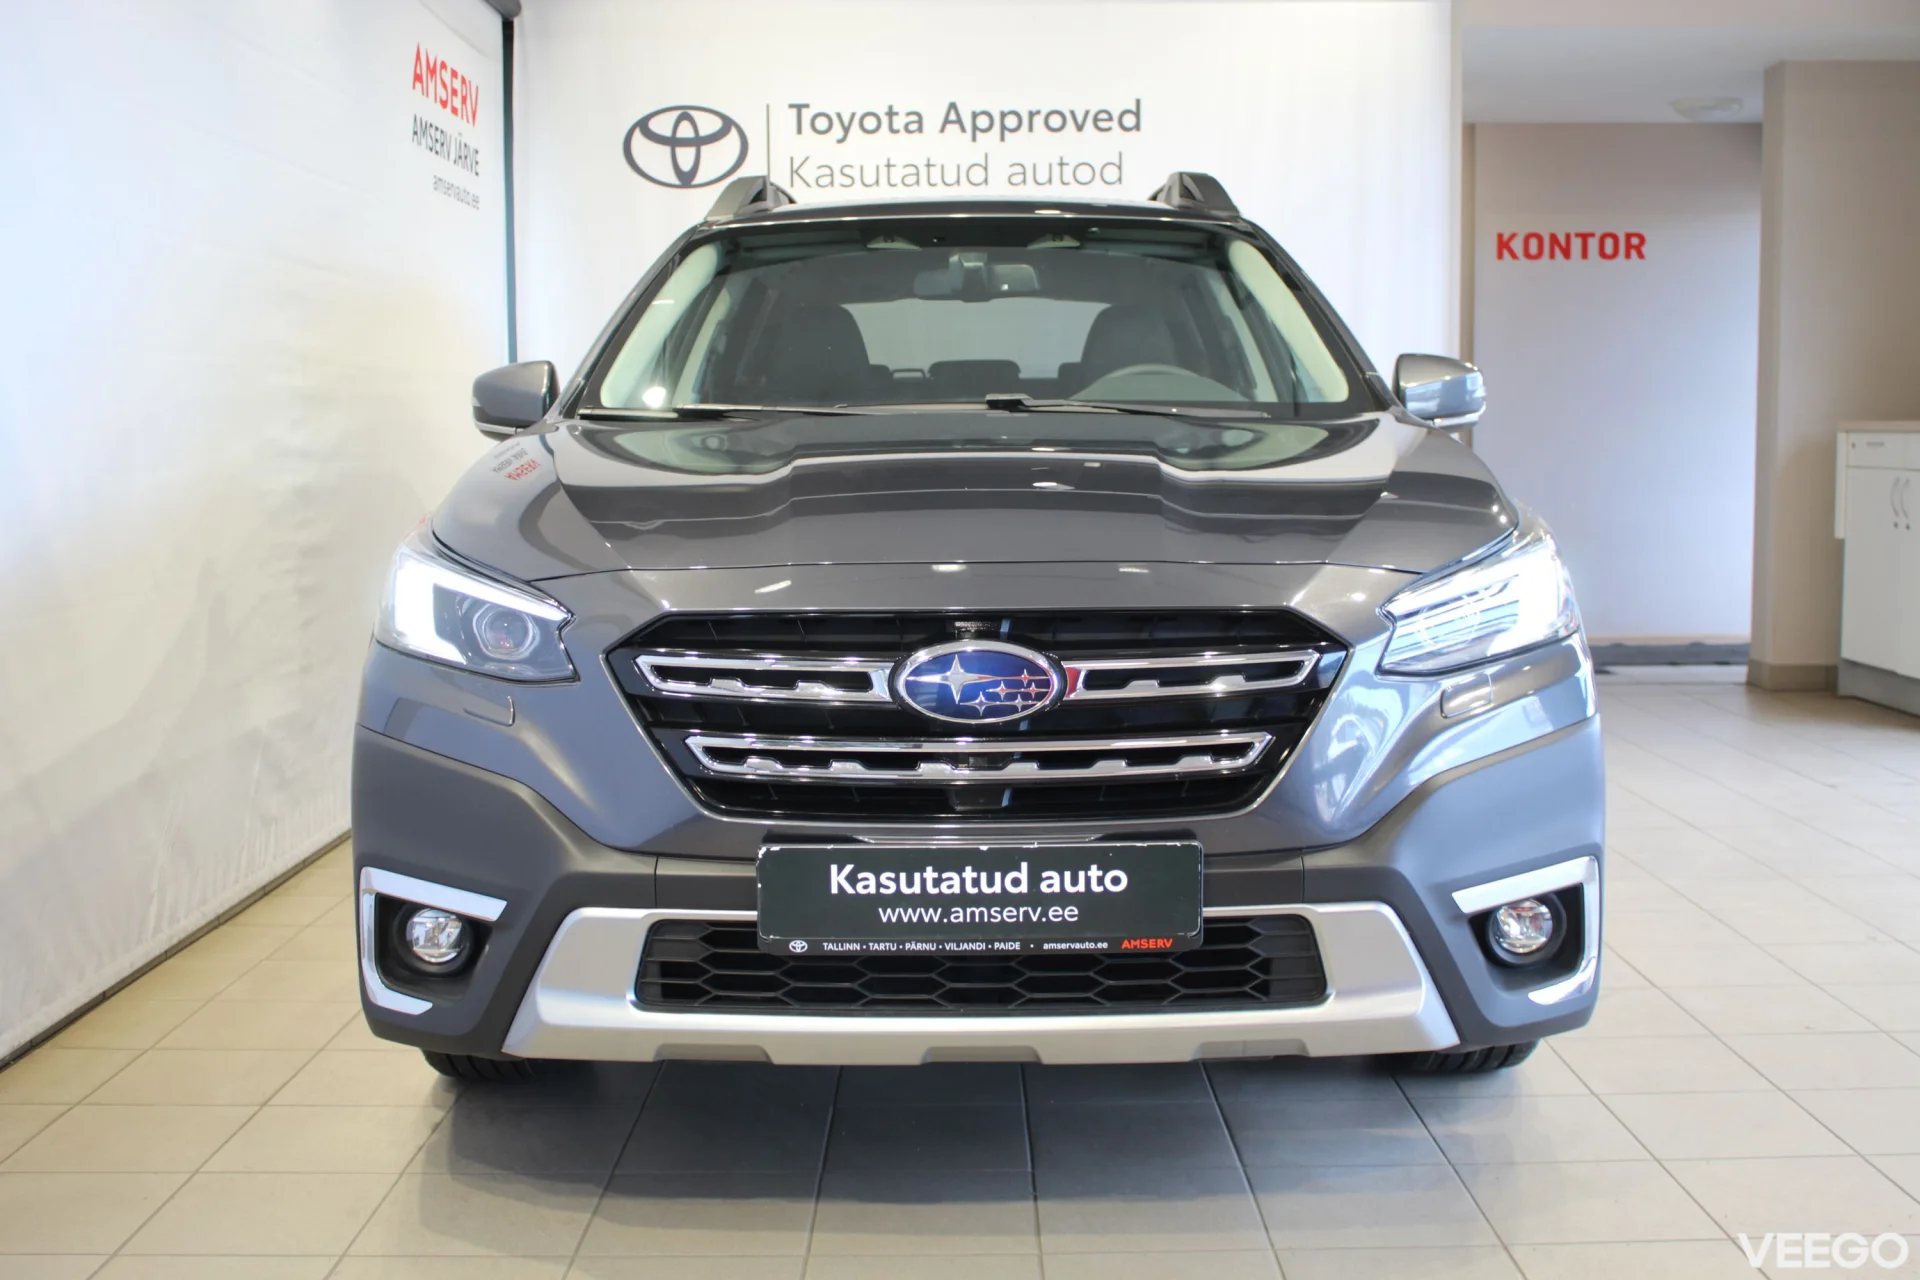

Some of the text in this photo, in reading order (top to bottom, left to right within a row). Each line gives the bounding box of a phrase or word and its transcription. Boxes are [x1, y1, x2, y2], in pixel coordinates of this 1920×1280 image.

[412, 42, 479, 128] AMSERV
[788, 98, 1143, 143] Toyota Approved
[411, 113, 480, 177] AMSERV JÄRVE
[788, 151, 1124, 188] Kasutatud autod
[1496, 231, 1646, 261] KONTOR
[829, 862, 1128, 895] Kasutatud auto
[878, 904, 1079, 924] www.amserv.ee
[822, 938, 1173, 951] TALLINN TARTU PÄRNU VILJANDI PAIDE amservauto.ee AMSERV
